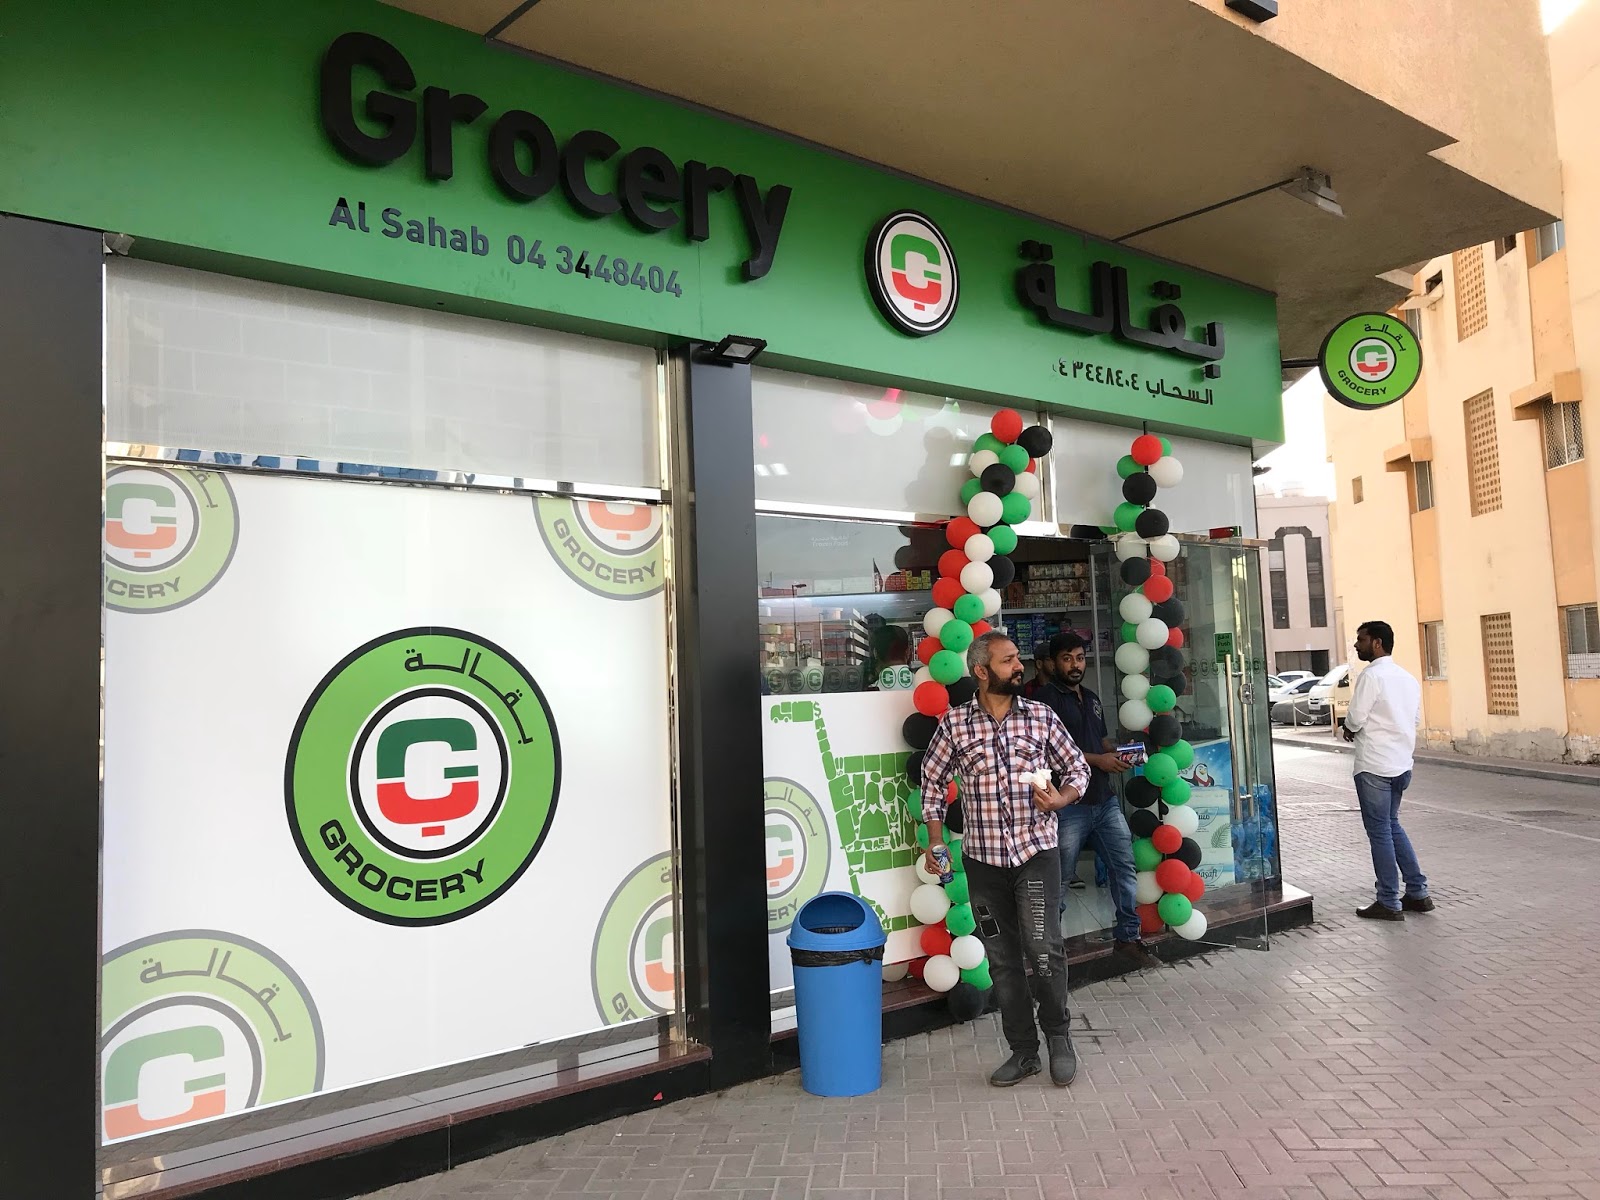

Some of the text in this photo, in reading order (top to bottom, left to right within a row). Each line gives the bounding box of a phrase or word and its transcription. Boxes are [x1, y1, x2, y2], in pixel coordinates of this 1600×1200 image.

[321, 32, 793, 281] Grocery
[329, 197, 683, 298] Al Sahab 04 3448404
[1018, 239, 1226, 379] بقالة
[1364, 323, 1406, 352] بقالة
[1145, 378, 1214, 405] السحاب
[1337, 369, 1387, 396] GROCERY
[553, 518, 657, 584] GROCERY
[404, 648, 534, 746] بقالة
[319, 819, 486, 902] GROCERY
[140, 947, 293, 1043] بقالة
